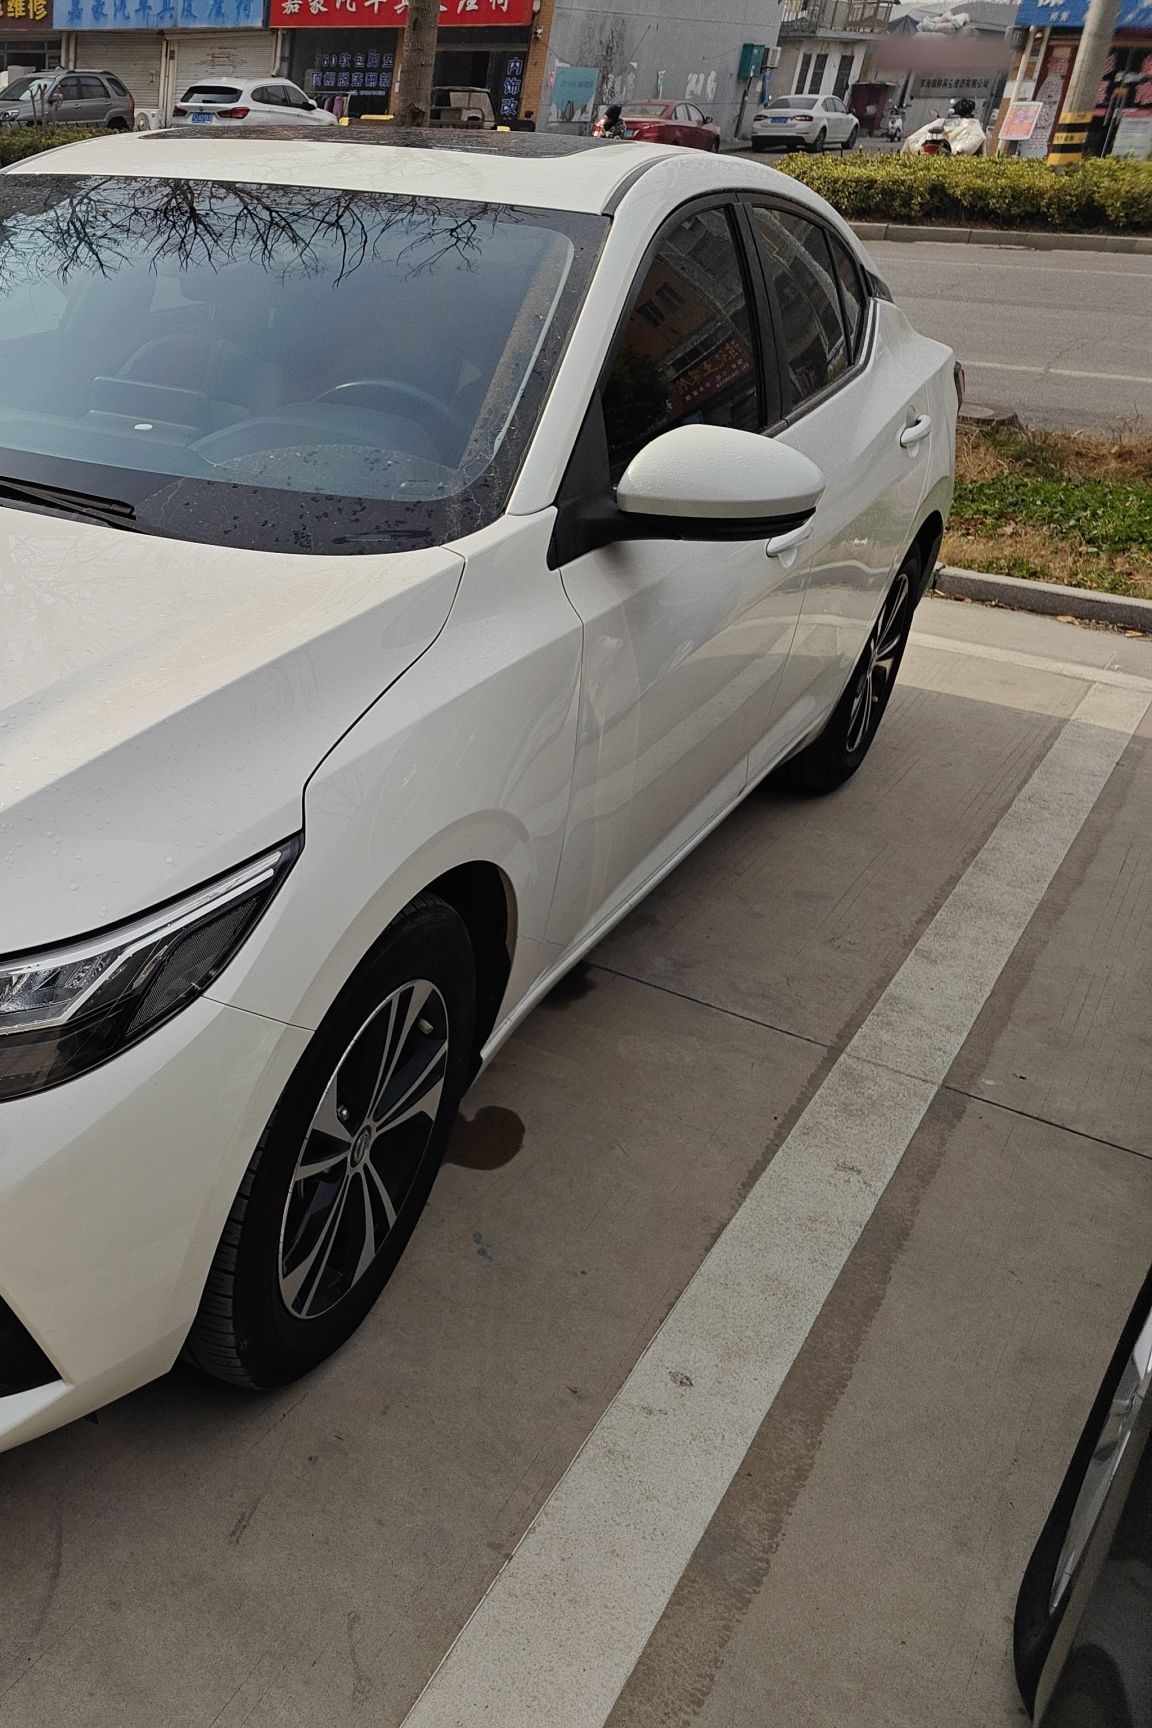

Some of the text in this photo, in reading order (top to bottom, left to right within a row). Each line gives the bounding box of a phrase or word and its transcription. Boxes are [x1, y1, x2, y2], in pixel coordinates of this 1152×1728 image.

[311, 71, 393, 87] 顶棚脱落翻新
